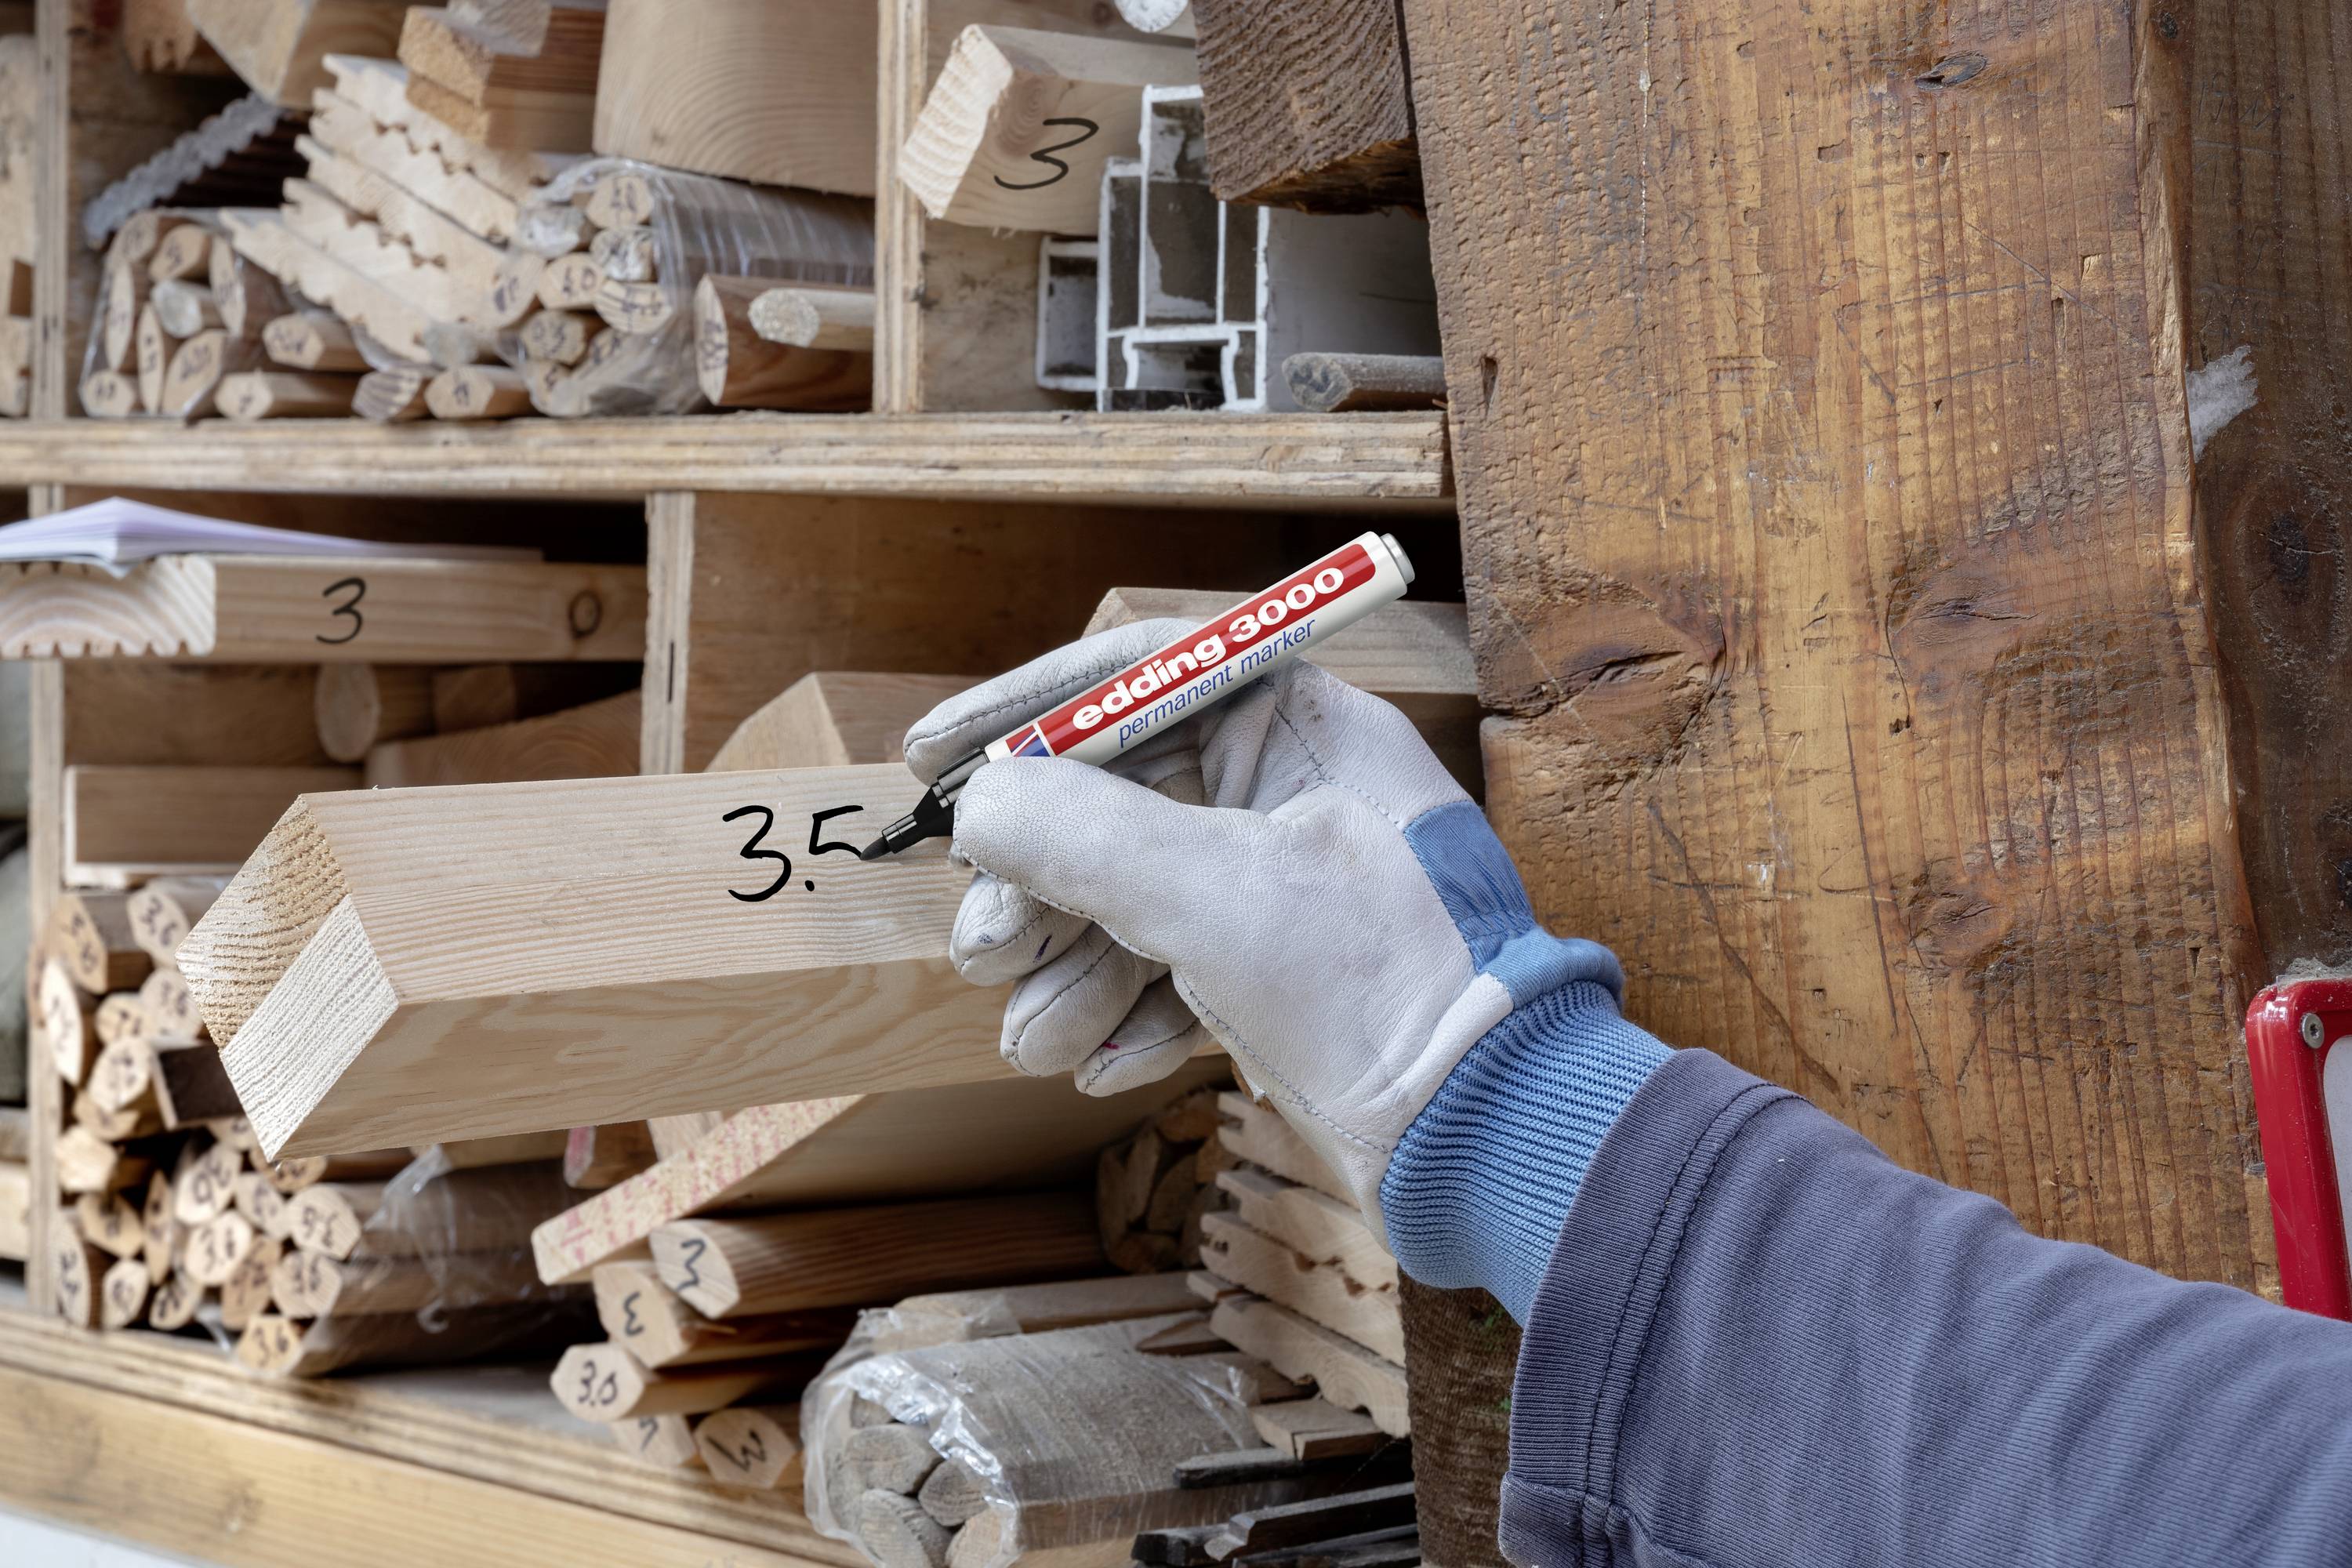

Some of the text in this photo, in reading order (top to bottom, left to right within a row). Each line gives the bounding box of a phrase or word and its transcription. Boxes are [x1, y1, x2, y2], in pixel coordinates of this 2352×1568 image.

[994, 117, 1099, 190] 3
[315, 576, 366, 644] 3
[1073, 567, 1345, 731] edding 3000
[1119, 618, 1316, 748] permanent marker
[722, 804, 864, 902] 3.5
